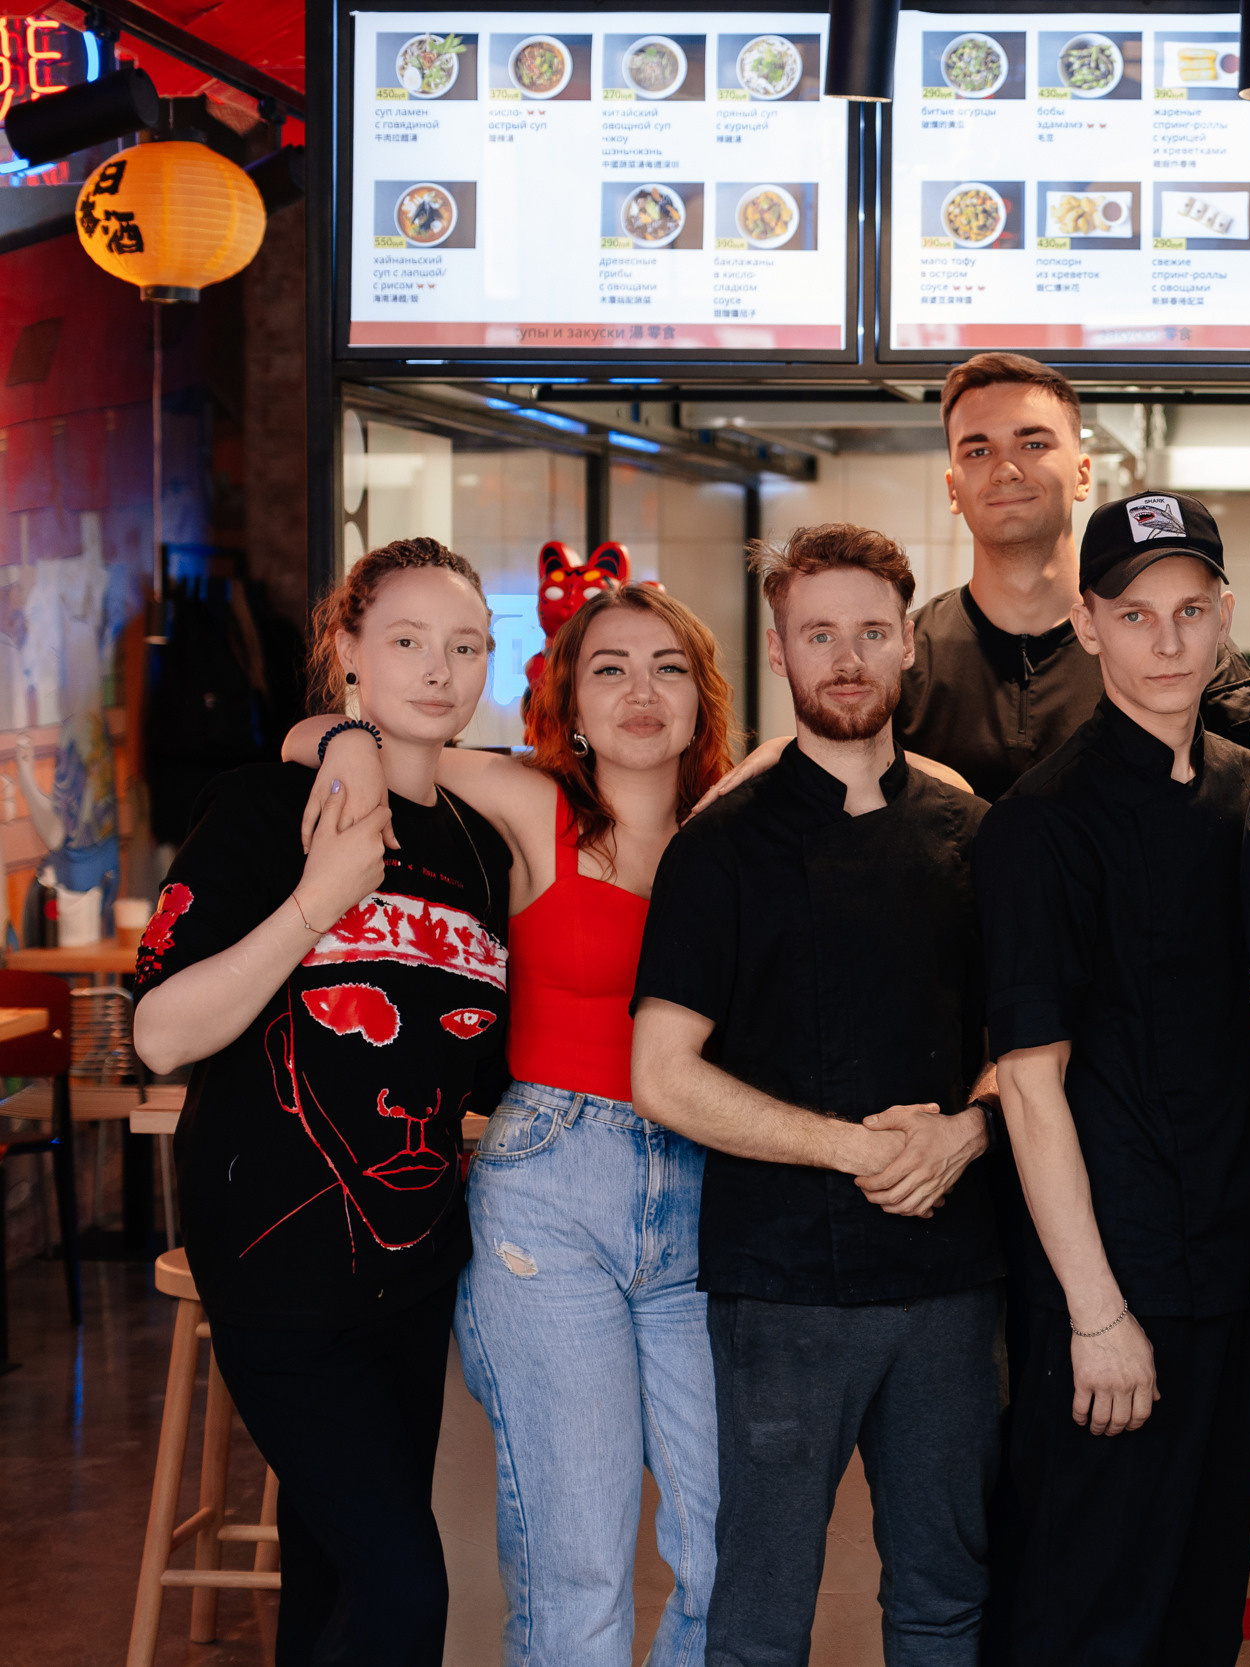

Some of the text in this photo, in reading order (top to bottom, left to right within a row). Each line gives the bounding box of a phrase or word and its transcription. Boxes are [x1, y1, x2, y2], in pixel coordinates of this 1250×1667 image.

[375, 109, 392, 118] суп
[382, 120, 439, 130] говядиной
[373, 269, 391, 279] суп
[381, 282, 413, 292] рисом
[713, 297, 741, 307] соусе
[553, 328, 562, 338] и
[567, 328, 625, 342] закуски
